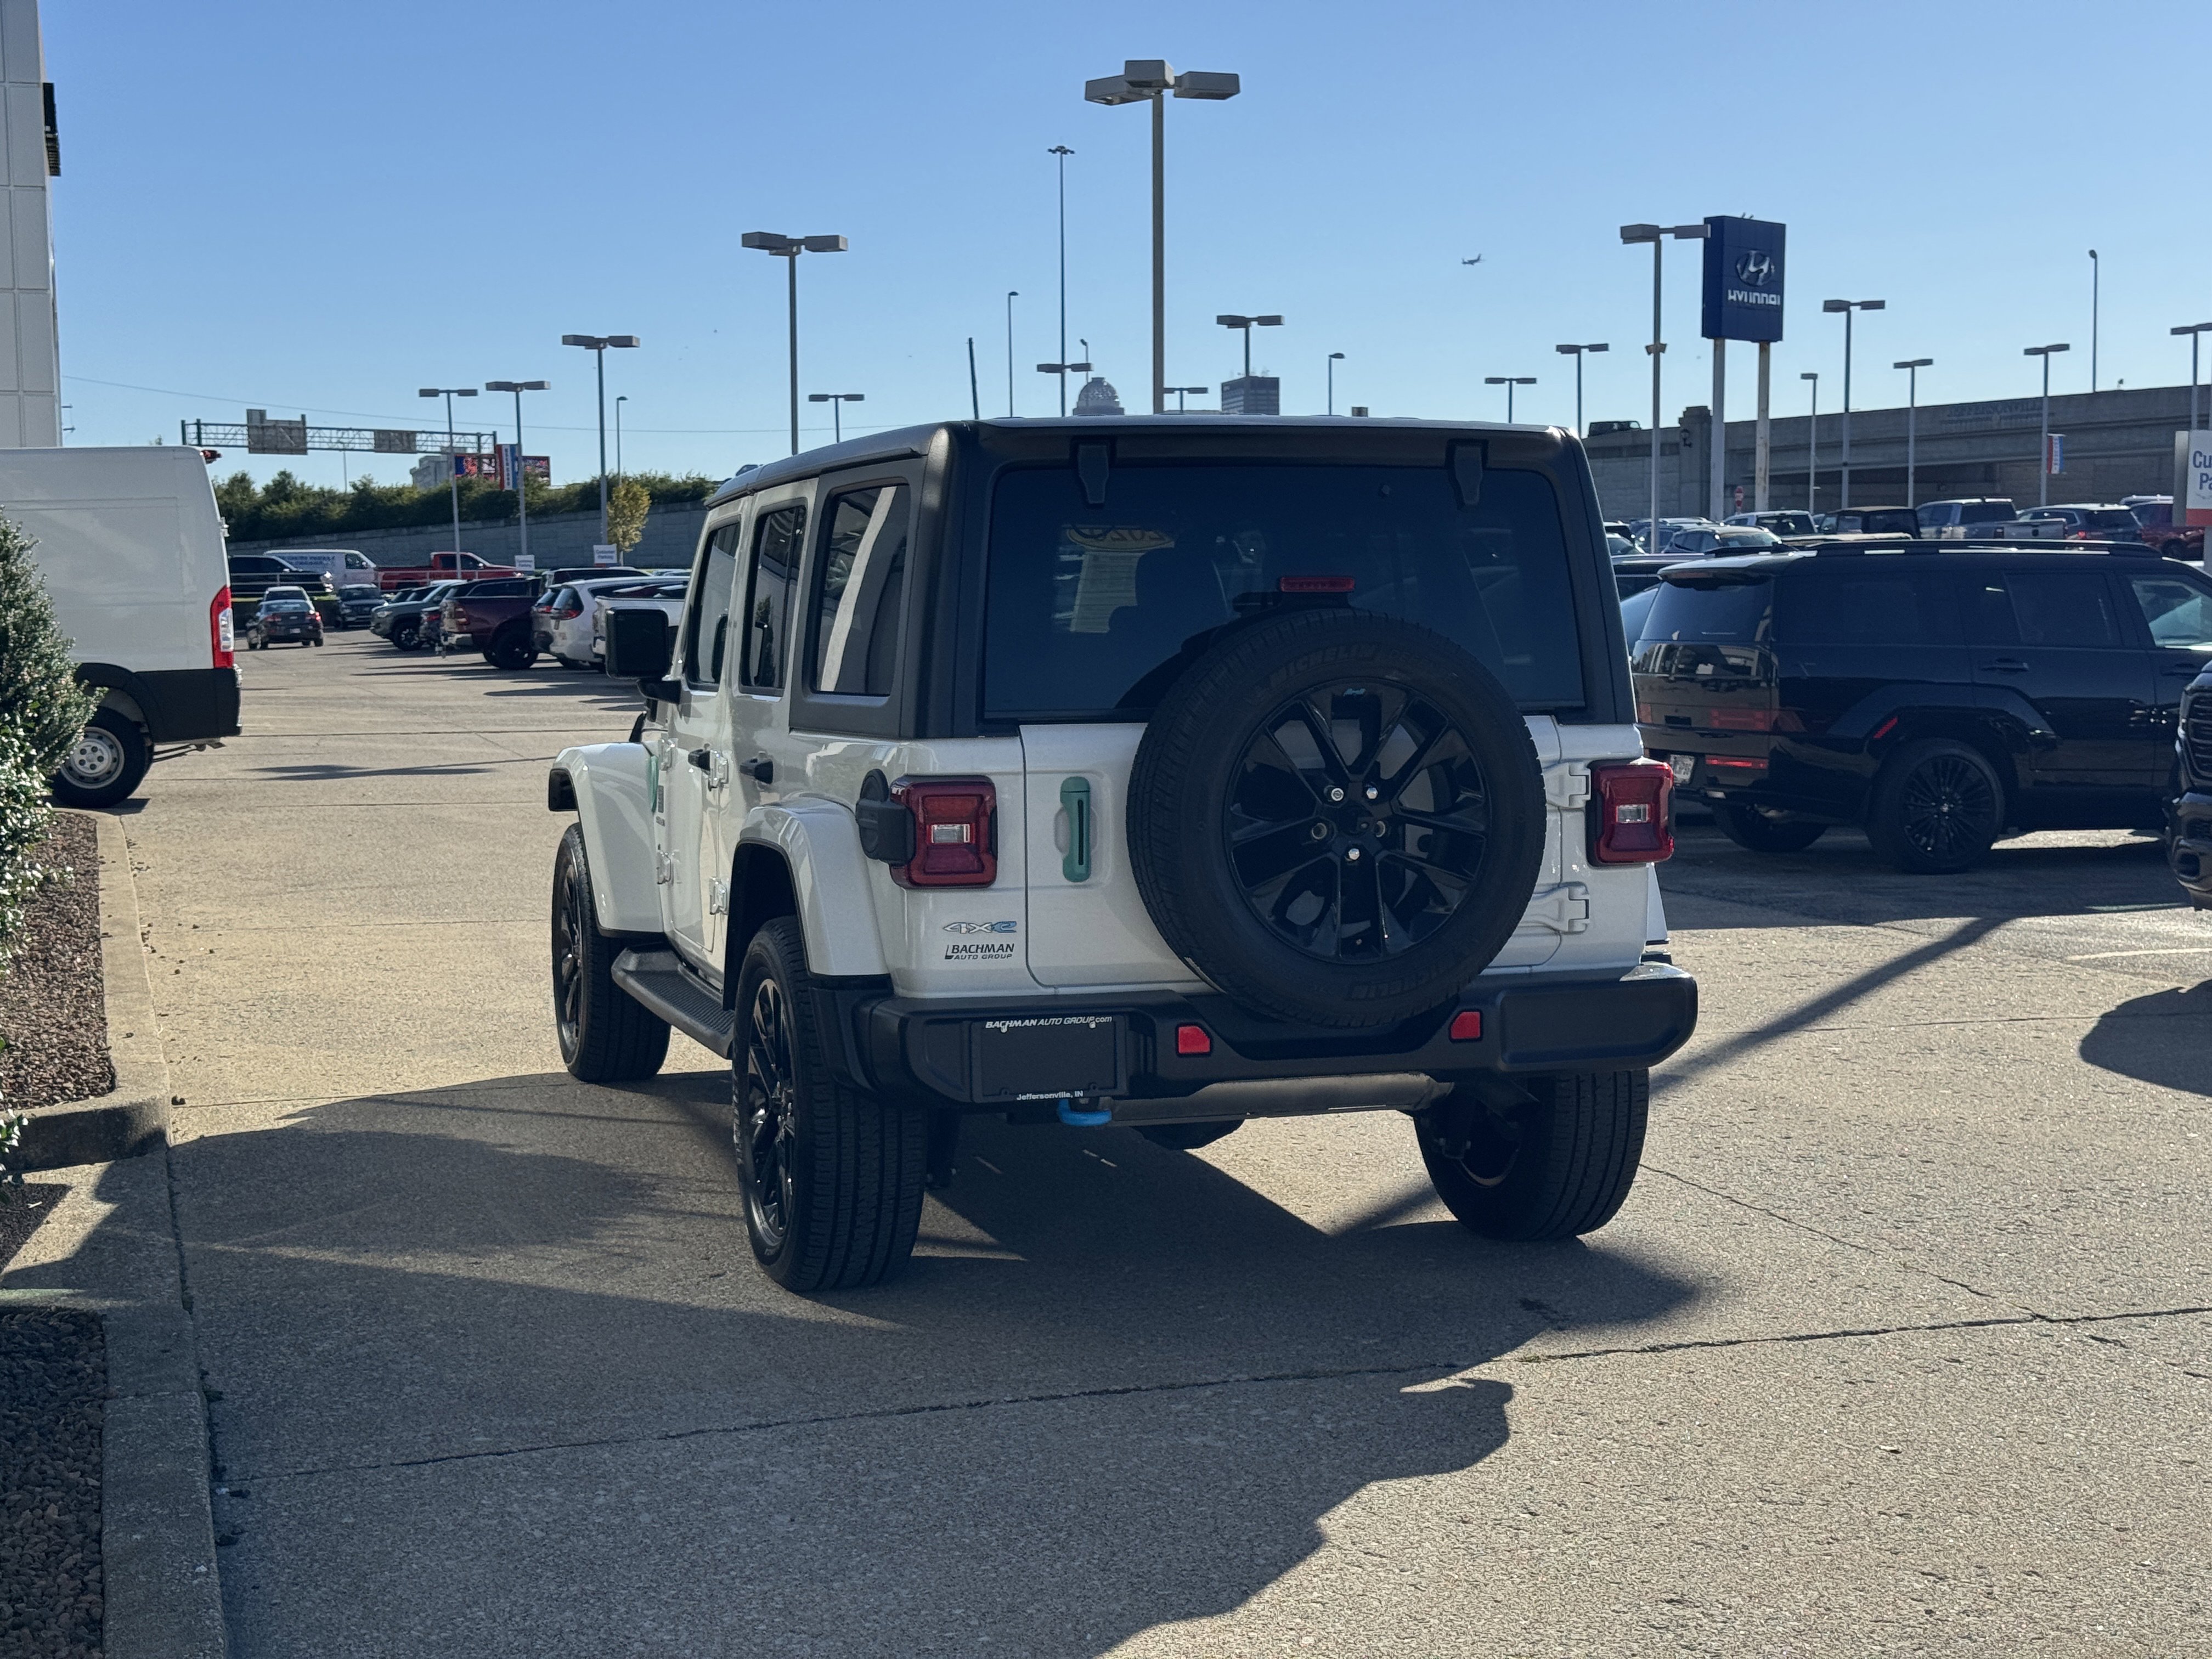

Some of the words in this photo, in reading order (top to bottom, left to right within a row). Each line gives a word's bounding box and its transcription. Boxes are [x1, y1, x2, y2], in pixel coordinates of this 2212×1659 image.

[1728, 289, 1780, 306] HYUNDAI
[1269, 644, 1378, 687] MICHELIN
[951, 944, 1014, 953] BACHMAN
[985, 1019, 1037, 1029] BACHMAN
[1017, 1092, 1073, 1101] Jeffersonville,
